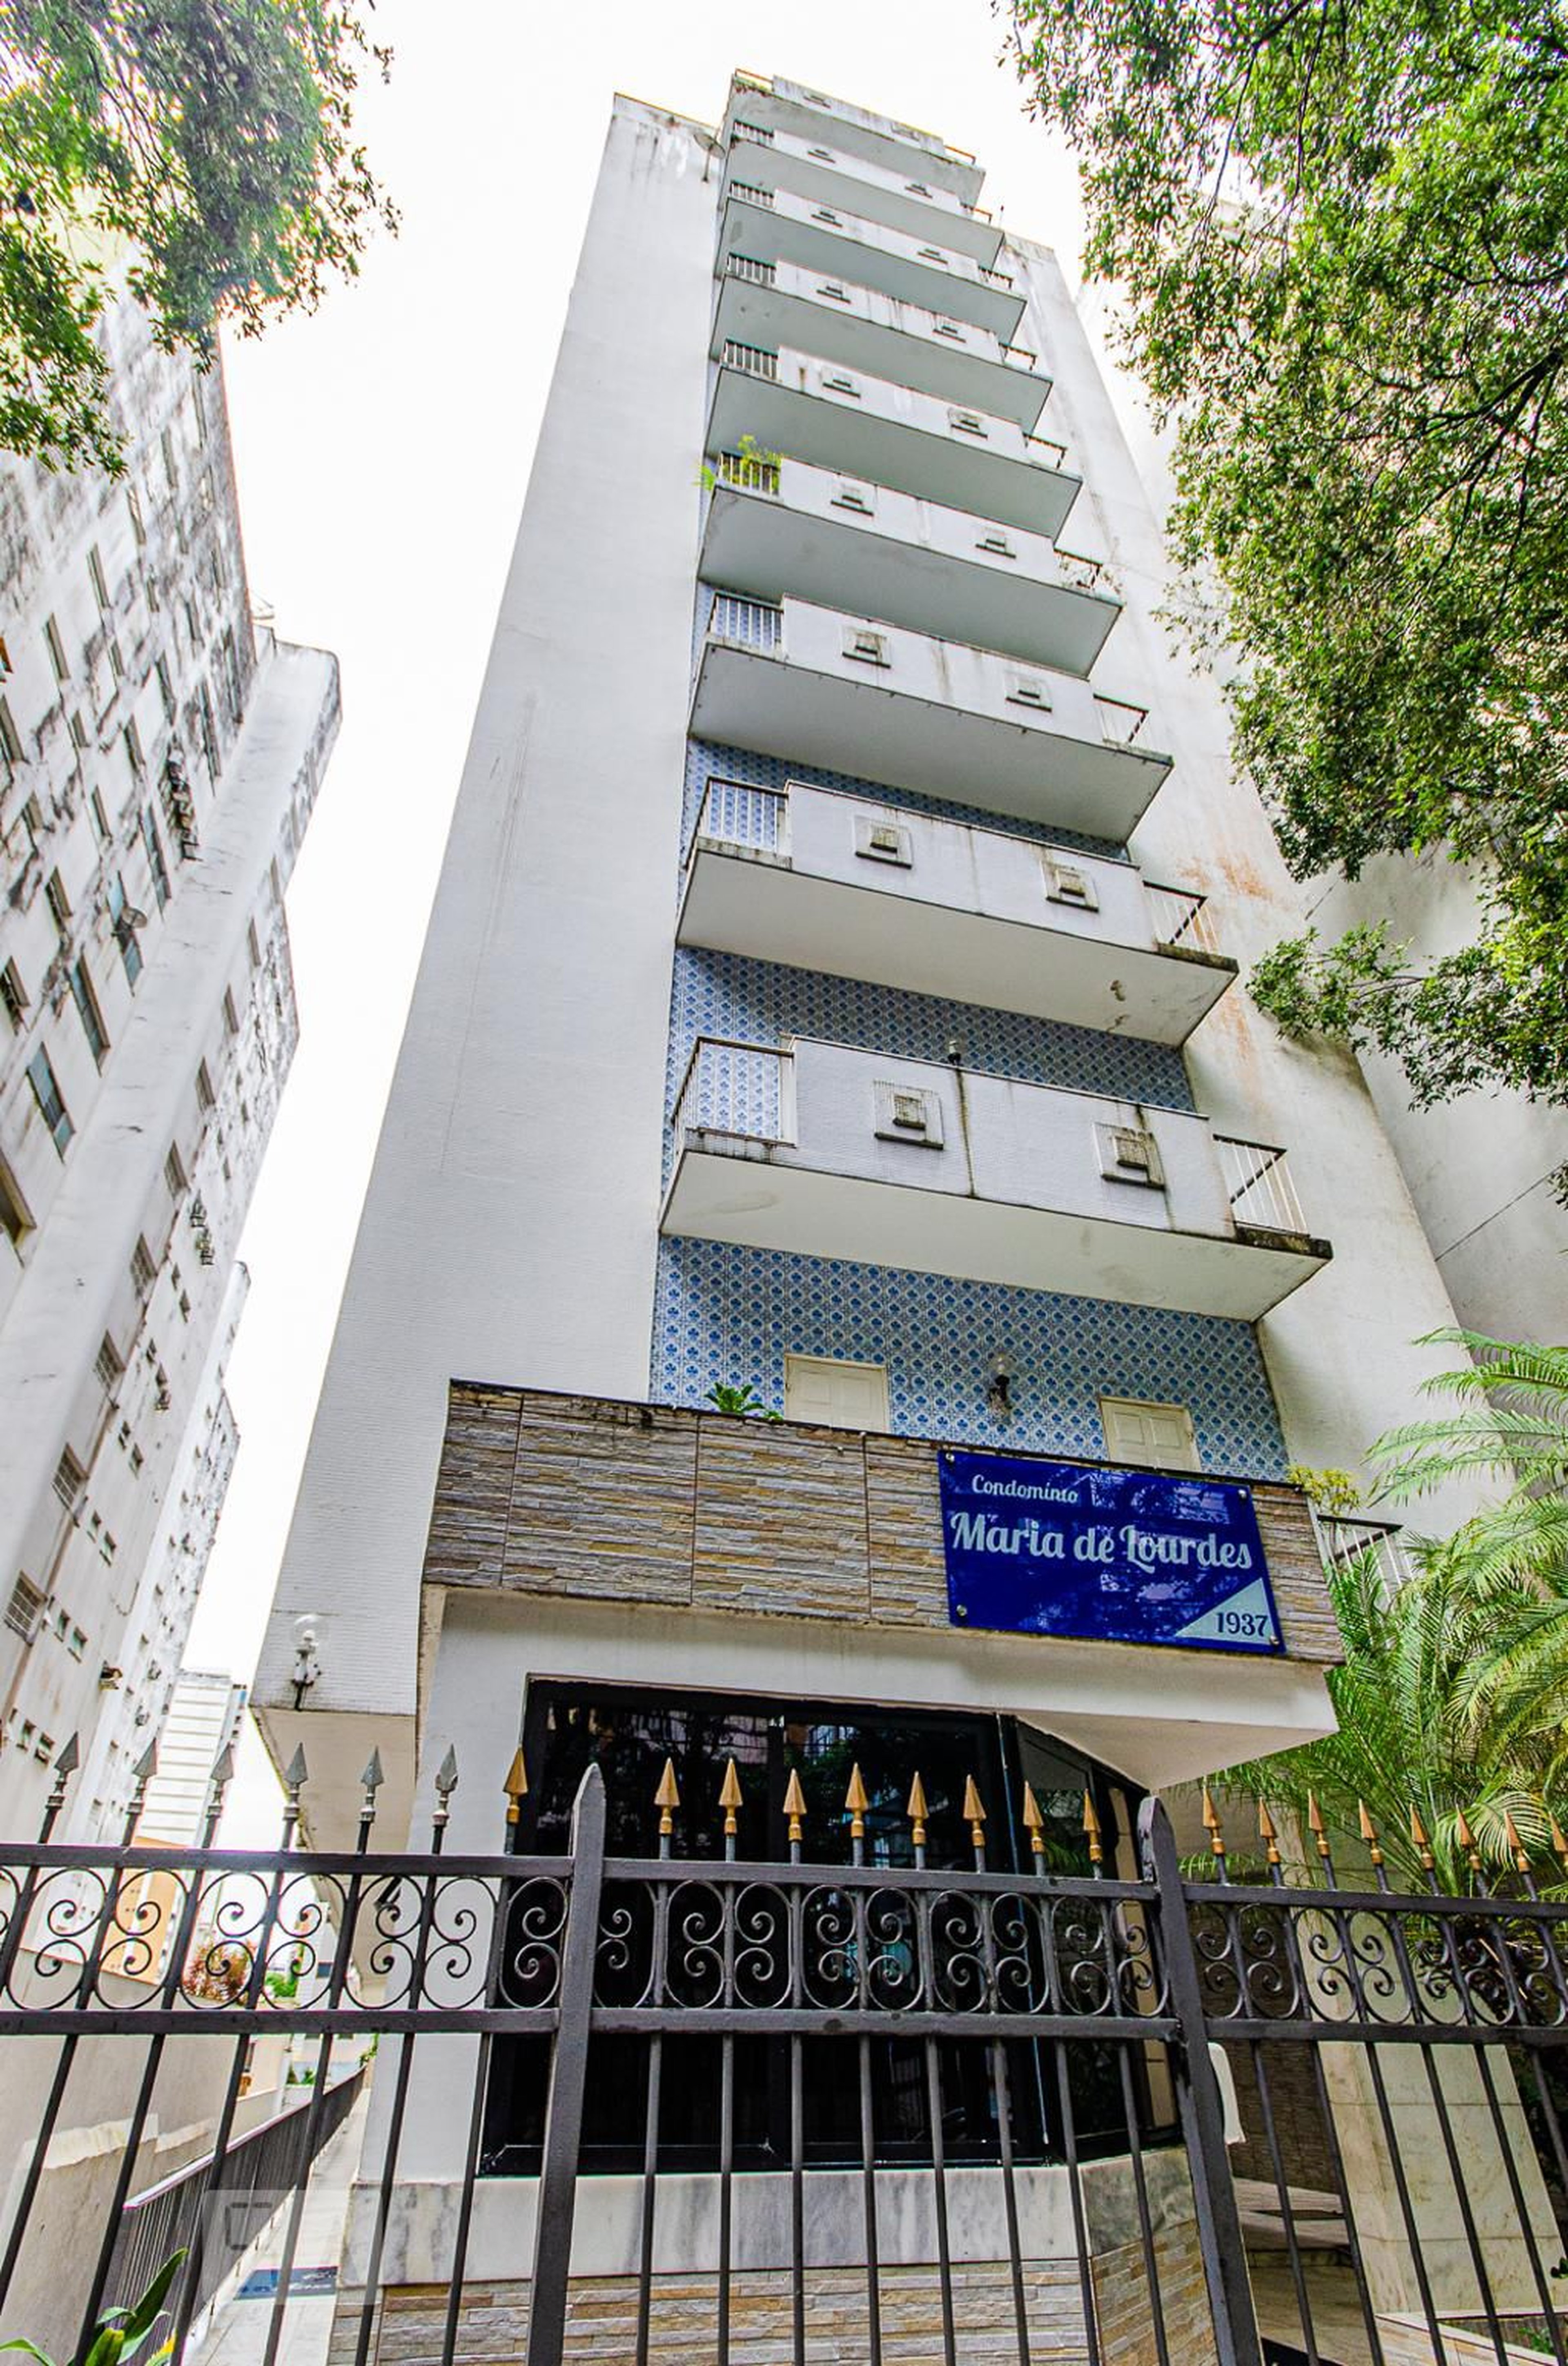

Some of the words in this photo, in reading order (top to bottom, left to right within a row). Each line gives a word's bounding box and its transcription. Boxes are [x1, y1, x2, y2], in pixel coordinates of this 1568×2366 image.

[950, 1512, 1065, 1559] Maria
[1073, 1528, 1115, 1564] de
[1119, 1524, 1252, 1574] Lourdes
[1216, 1612, 1268, 1637] 1937
